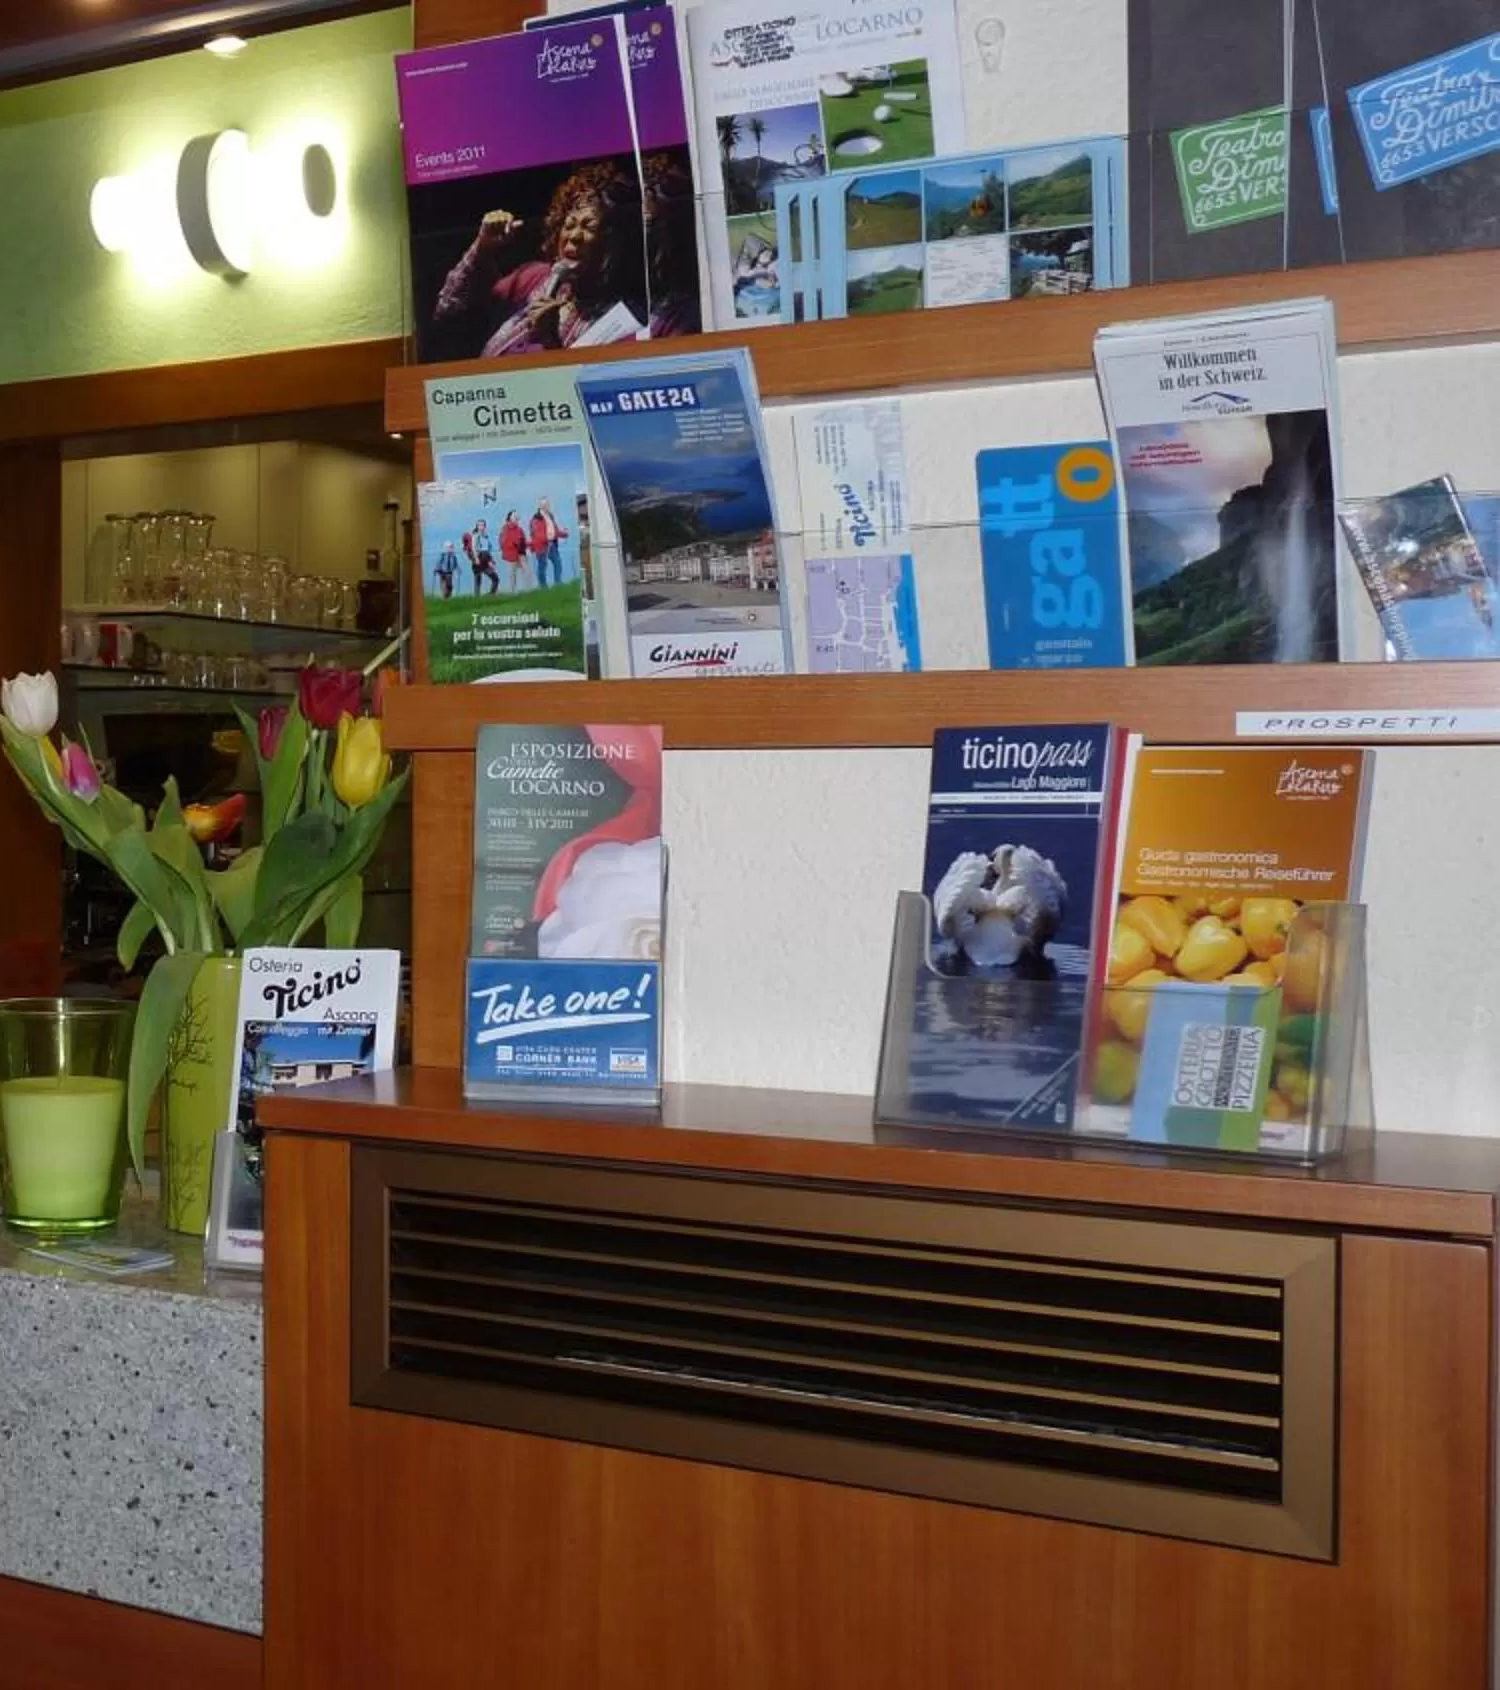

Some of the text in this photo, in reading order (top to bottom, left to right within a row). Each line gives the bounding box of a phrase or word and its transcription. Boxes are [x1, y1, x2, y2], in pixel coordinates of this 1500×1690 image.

[815, 7, 923, 41] LOCARNO
[415, 145, 486, 170] Events 2011
[1164, 349, 1257, 370] Willkommen
[1159, 377, 1173, 391] in
[1177, 373, 1200, 389] der
[432, 387, 506, 406] Capanna
[474, 401, 573, 427] Cimetta
[833, 482, 877, 547] Ticino
[480, 611, 539, 625] escursioni
[453, 630, 472, 643] per
[487, 628, 522, 640] vostra
[525, 626, 561, 639] salute
[1264, 716, 1458, 729] PROSPETTI
[511, 742, 637, 760] ESPOSIZIONE
[511, 780, 605, 796] LOCARNO
[1011, 776, 1036, 790] Lago
[1039, 776, 1087, 790] Maggiore
[1139, 848, 1278, 864] Guida gastronomica
[1137, 864, 1336, 881] Gastronomische Reiseführer
[249, 957, 303, 973] Osteria
[263, 957, 361, 1019] Ticino
[472, 973, 651, 1024] Take one!
[323, 1007, 378, 1021] Ascona
[1232, 1030, 1261, 1110] PIZZERIA
